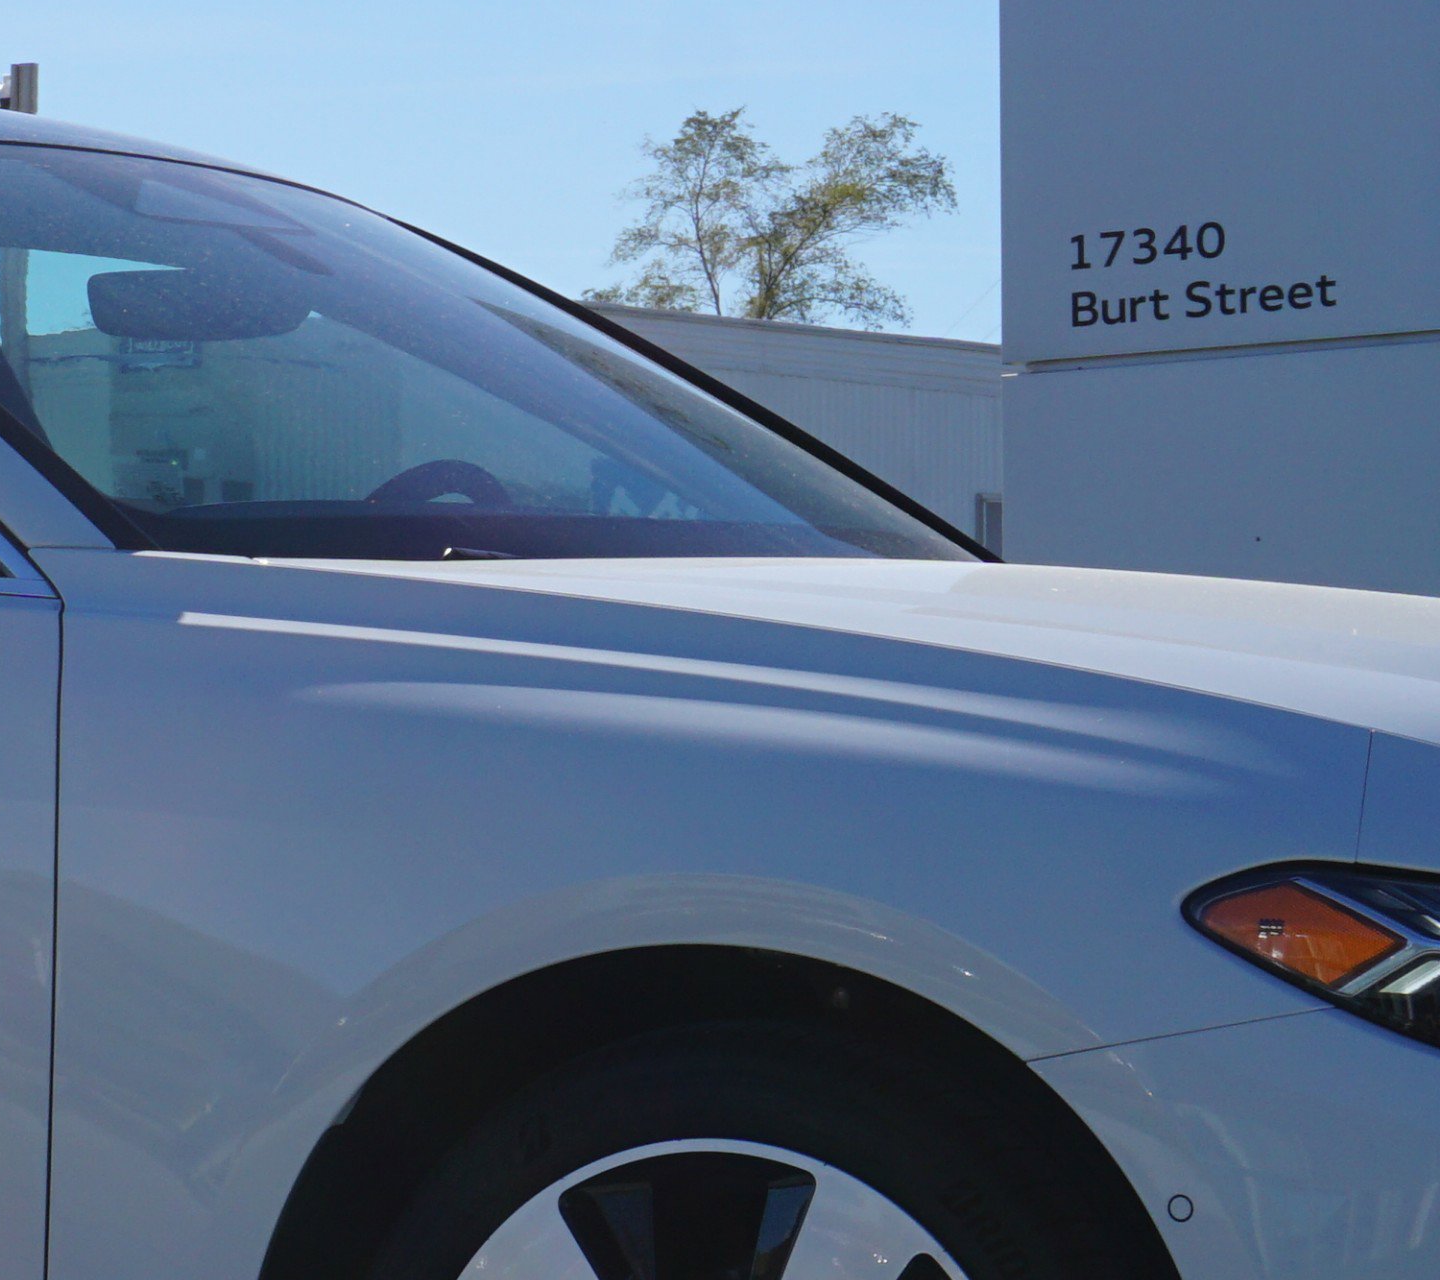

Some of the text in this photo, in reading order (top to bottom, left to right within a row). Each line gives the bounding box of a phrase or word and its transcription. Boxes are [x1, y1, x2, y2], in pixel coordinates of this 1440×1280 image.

[1070, 221, 1226, 270] 17340
[1071, 274, 1337, 328] Burt Street
